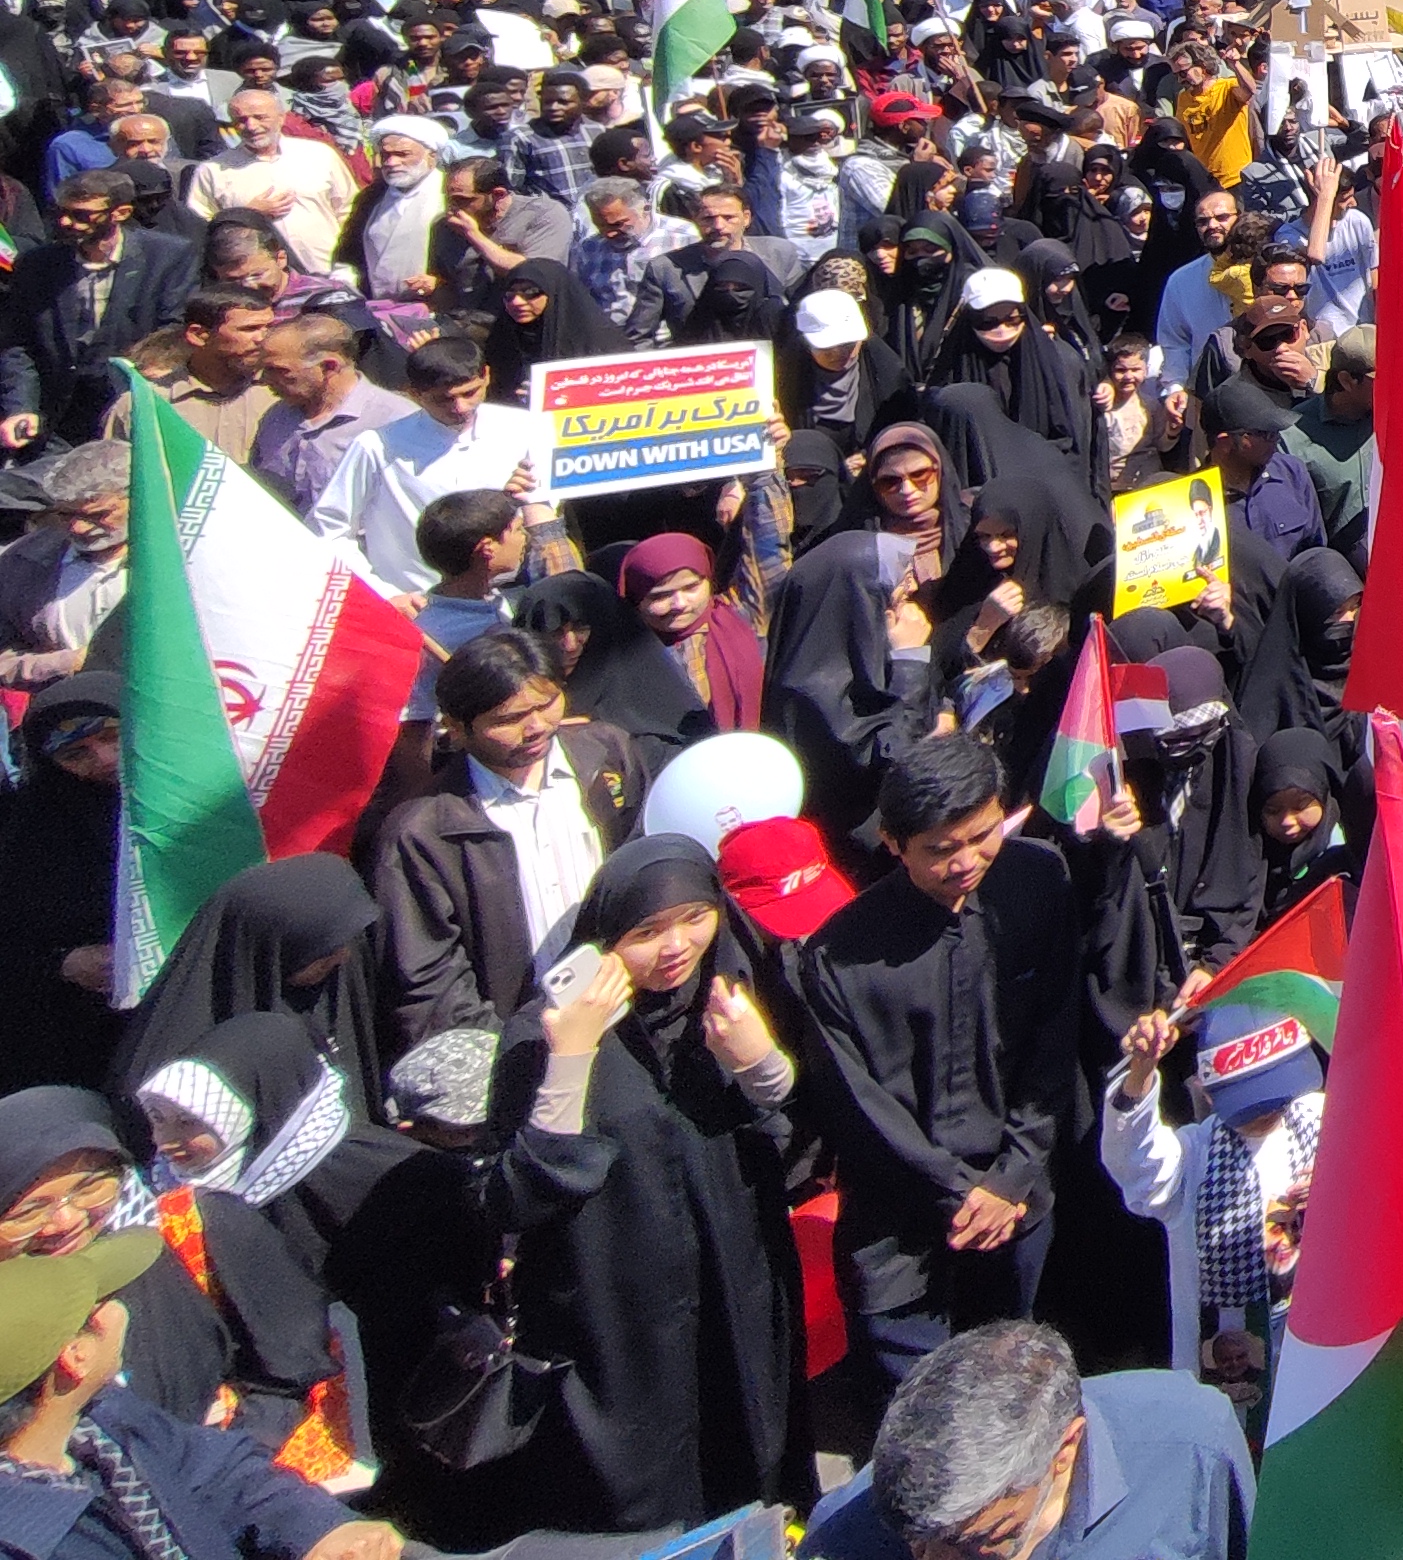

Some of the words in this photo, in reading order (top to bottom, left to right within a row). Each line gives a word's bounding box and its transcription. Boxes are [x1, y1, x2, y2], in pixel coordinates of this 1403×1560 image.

[550, 375, 589, 391] فلسطین
[658, 408, 689, 431] بر
[690, 396, 760, 421] مرگ
[561, 402, 659, 441] آمریکا
[555, 447, 639, 477] DOWN
[642, 439, 709, 466] WITH
[713, 433, 761, 456] USA
